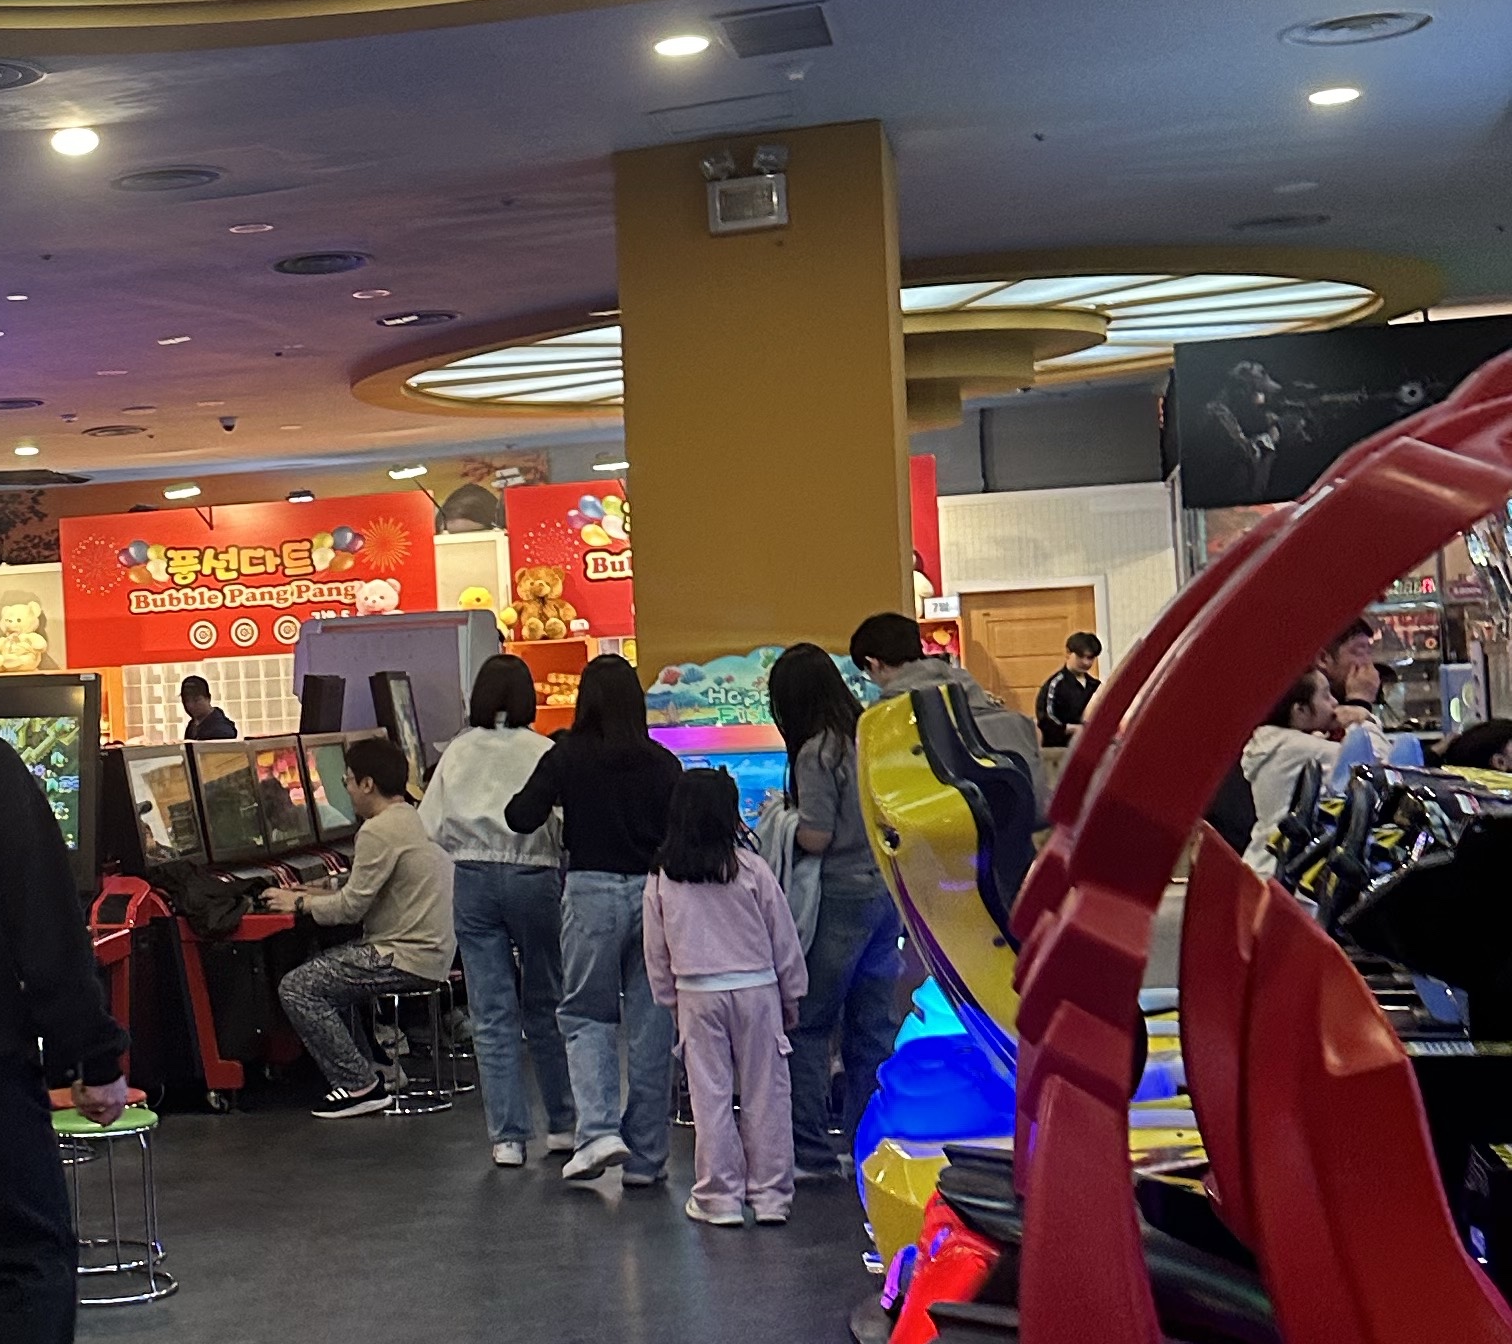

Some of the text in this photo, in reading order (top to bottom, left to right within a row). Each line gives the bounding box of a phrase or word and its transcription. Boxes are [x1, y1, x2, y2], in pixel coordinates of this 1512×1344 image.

[166, 540, 315, 585] 풍선다트
[134, 582, 356, 610] Bubble Pang Pang
